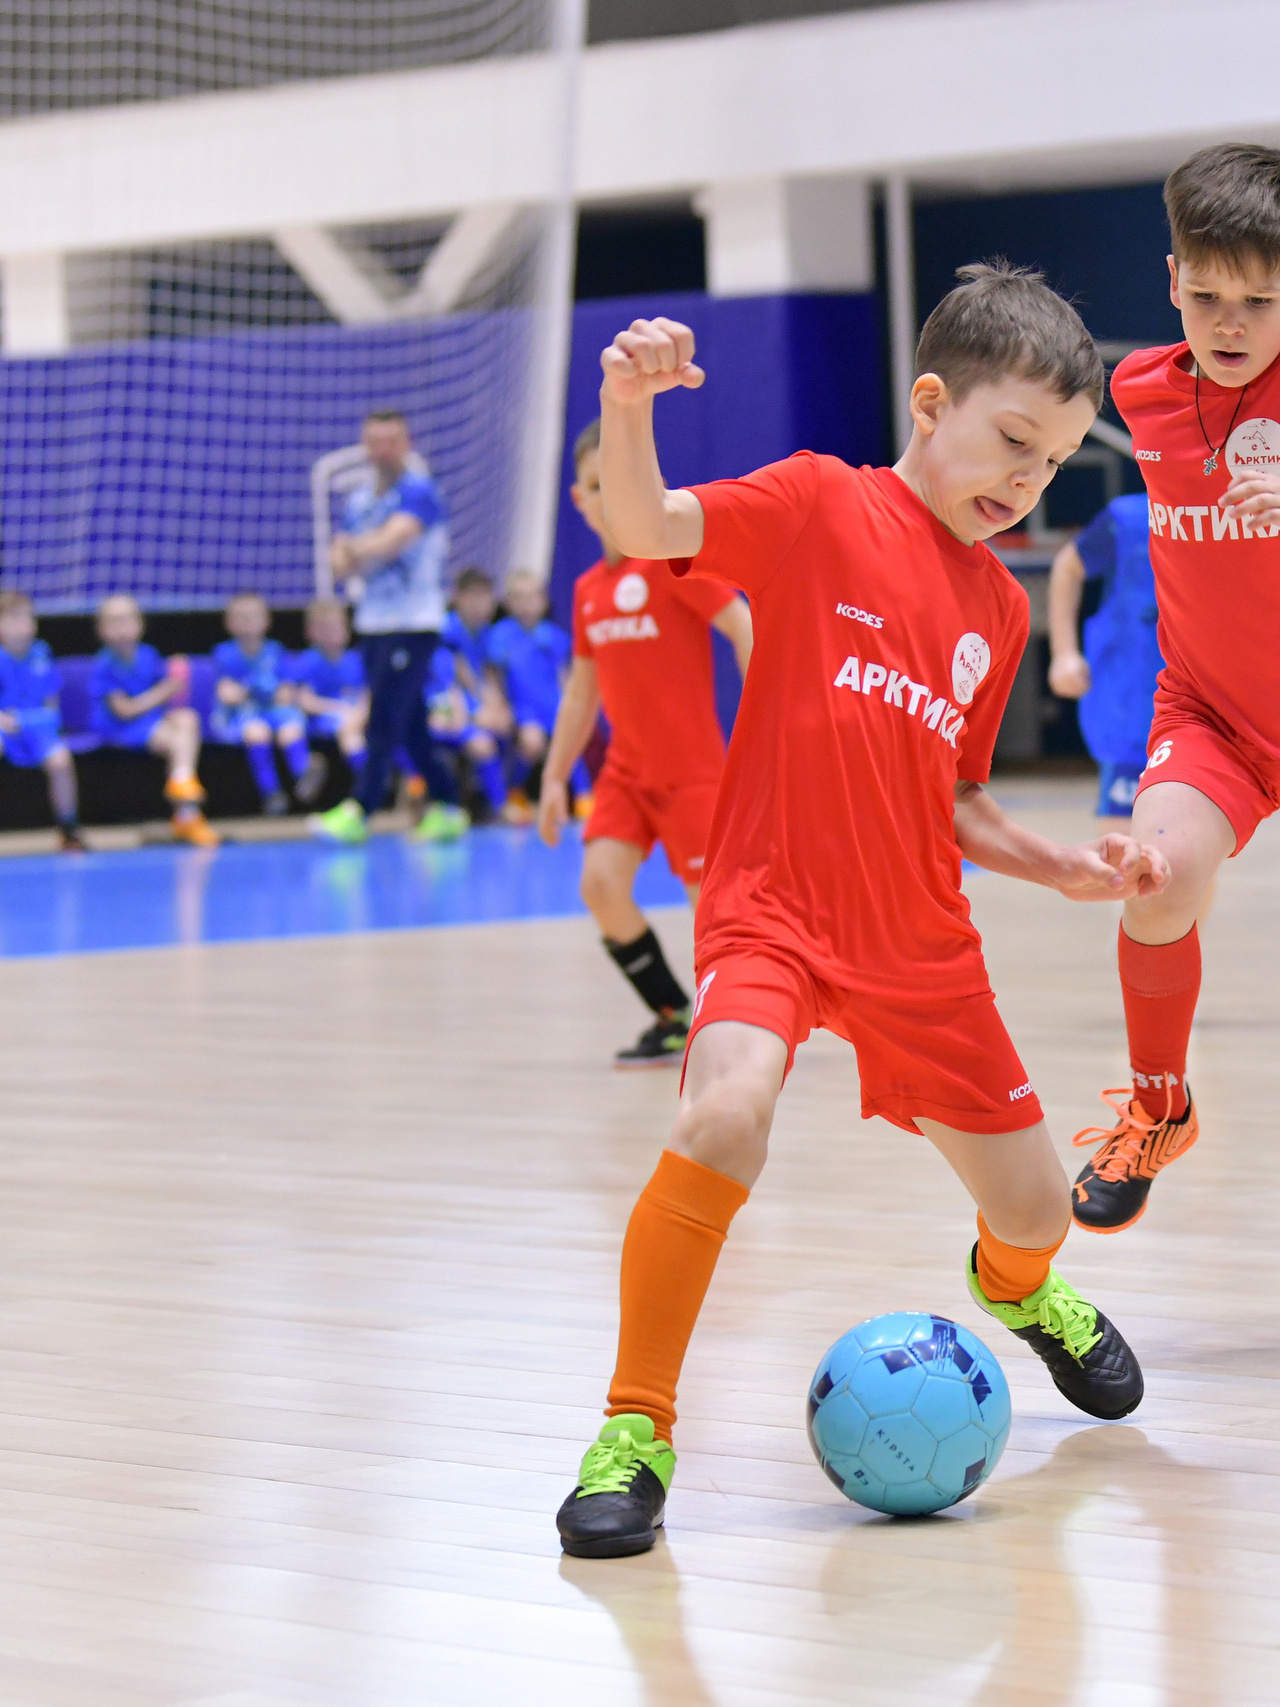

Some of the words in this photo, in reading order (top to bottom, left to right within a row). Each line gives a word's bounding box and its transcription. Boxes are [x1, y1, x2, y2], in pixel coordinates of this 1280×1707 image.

[836, 602, 885, 629] KODES
[833, 655, 965, 749] АРКТИКА
[876, 1429, 915, 1472] KIPSTA
